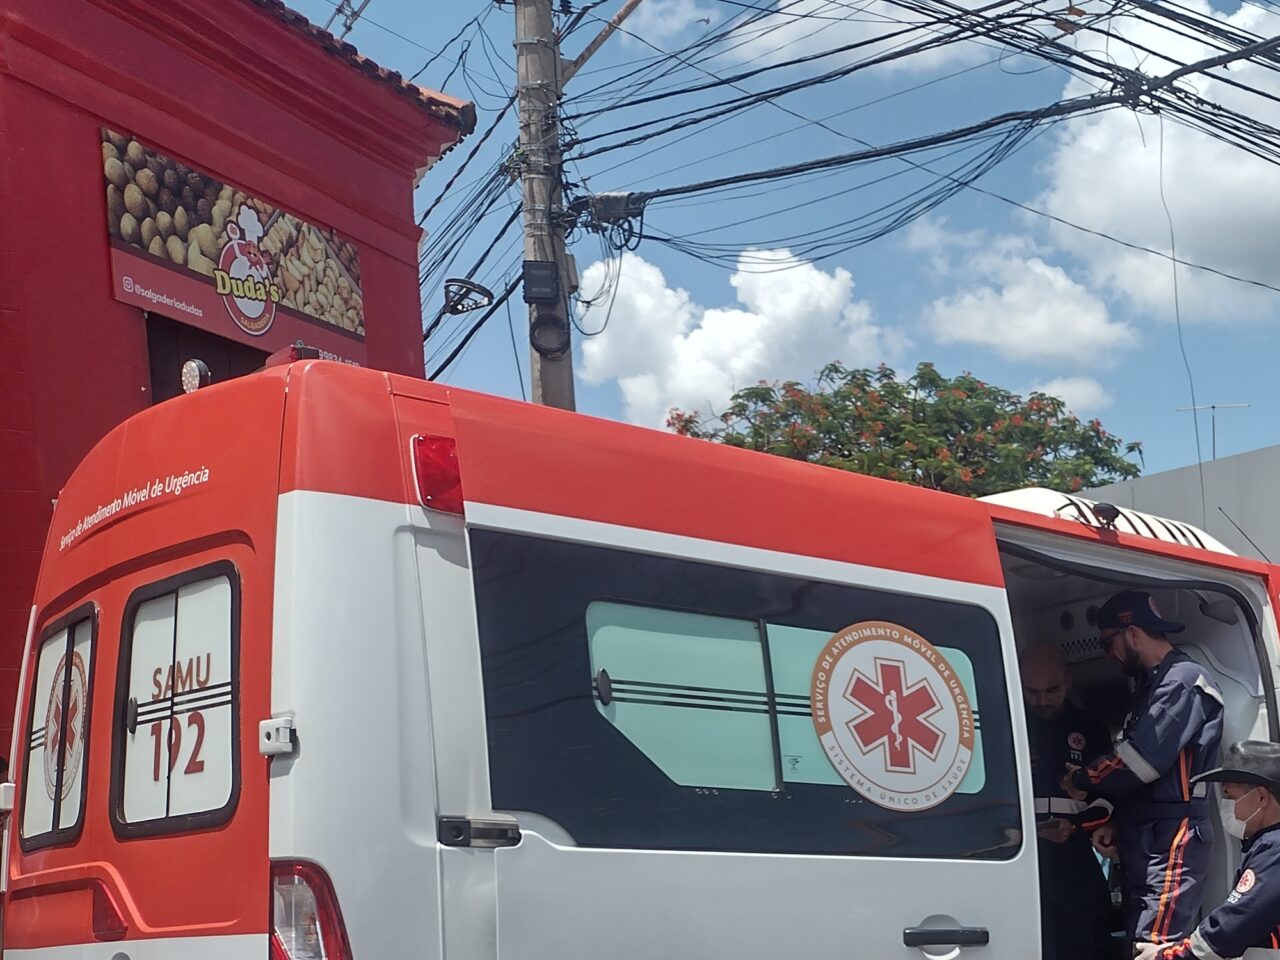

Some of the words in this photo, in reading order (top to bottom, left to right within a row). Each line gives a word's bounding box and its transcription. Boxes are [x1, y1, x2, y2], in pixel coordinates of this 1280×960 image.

[214, 268, 280, 303] Duda's
[82, 498, 122, 532] Atendimento
[123, 482, 150, 509] Móvel
[151, 479, 164, 498] de
[164, 466, 210, 495] Urgência
[821, 654, 836, 670] DE
[831, 627, 900, 656] ATENDIMENTO
[903, 634, 937, 663] MÓVEL
[151, 652, 211, 701] SAMU
[938, 663, 951, 678] DE
[816, 672, 827, 723] SERVIÇO
[949, 679, 970, 739] URGÊNCIA
[150, 710, 206, 782] 192
[828, 745, 873, 794] SISTEMA
[924, 791, 938, 802] DE
